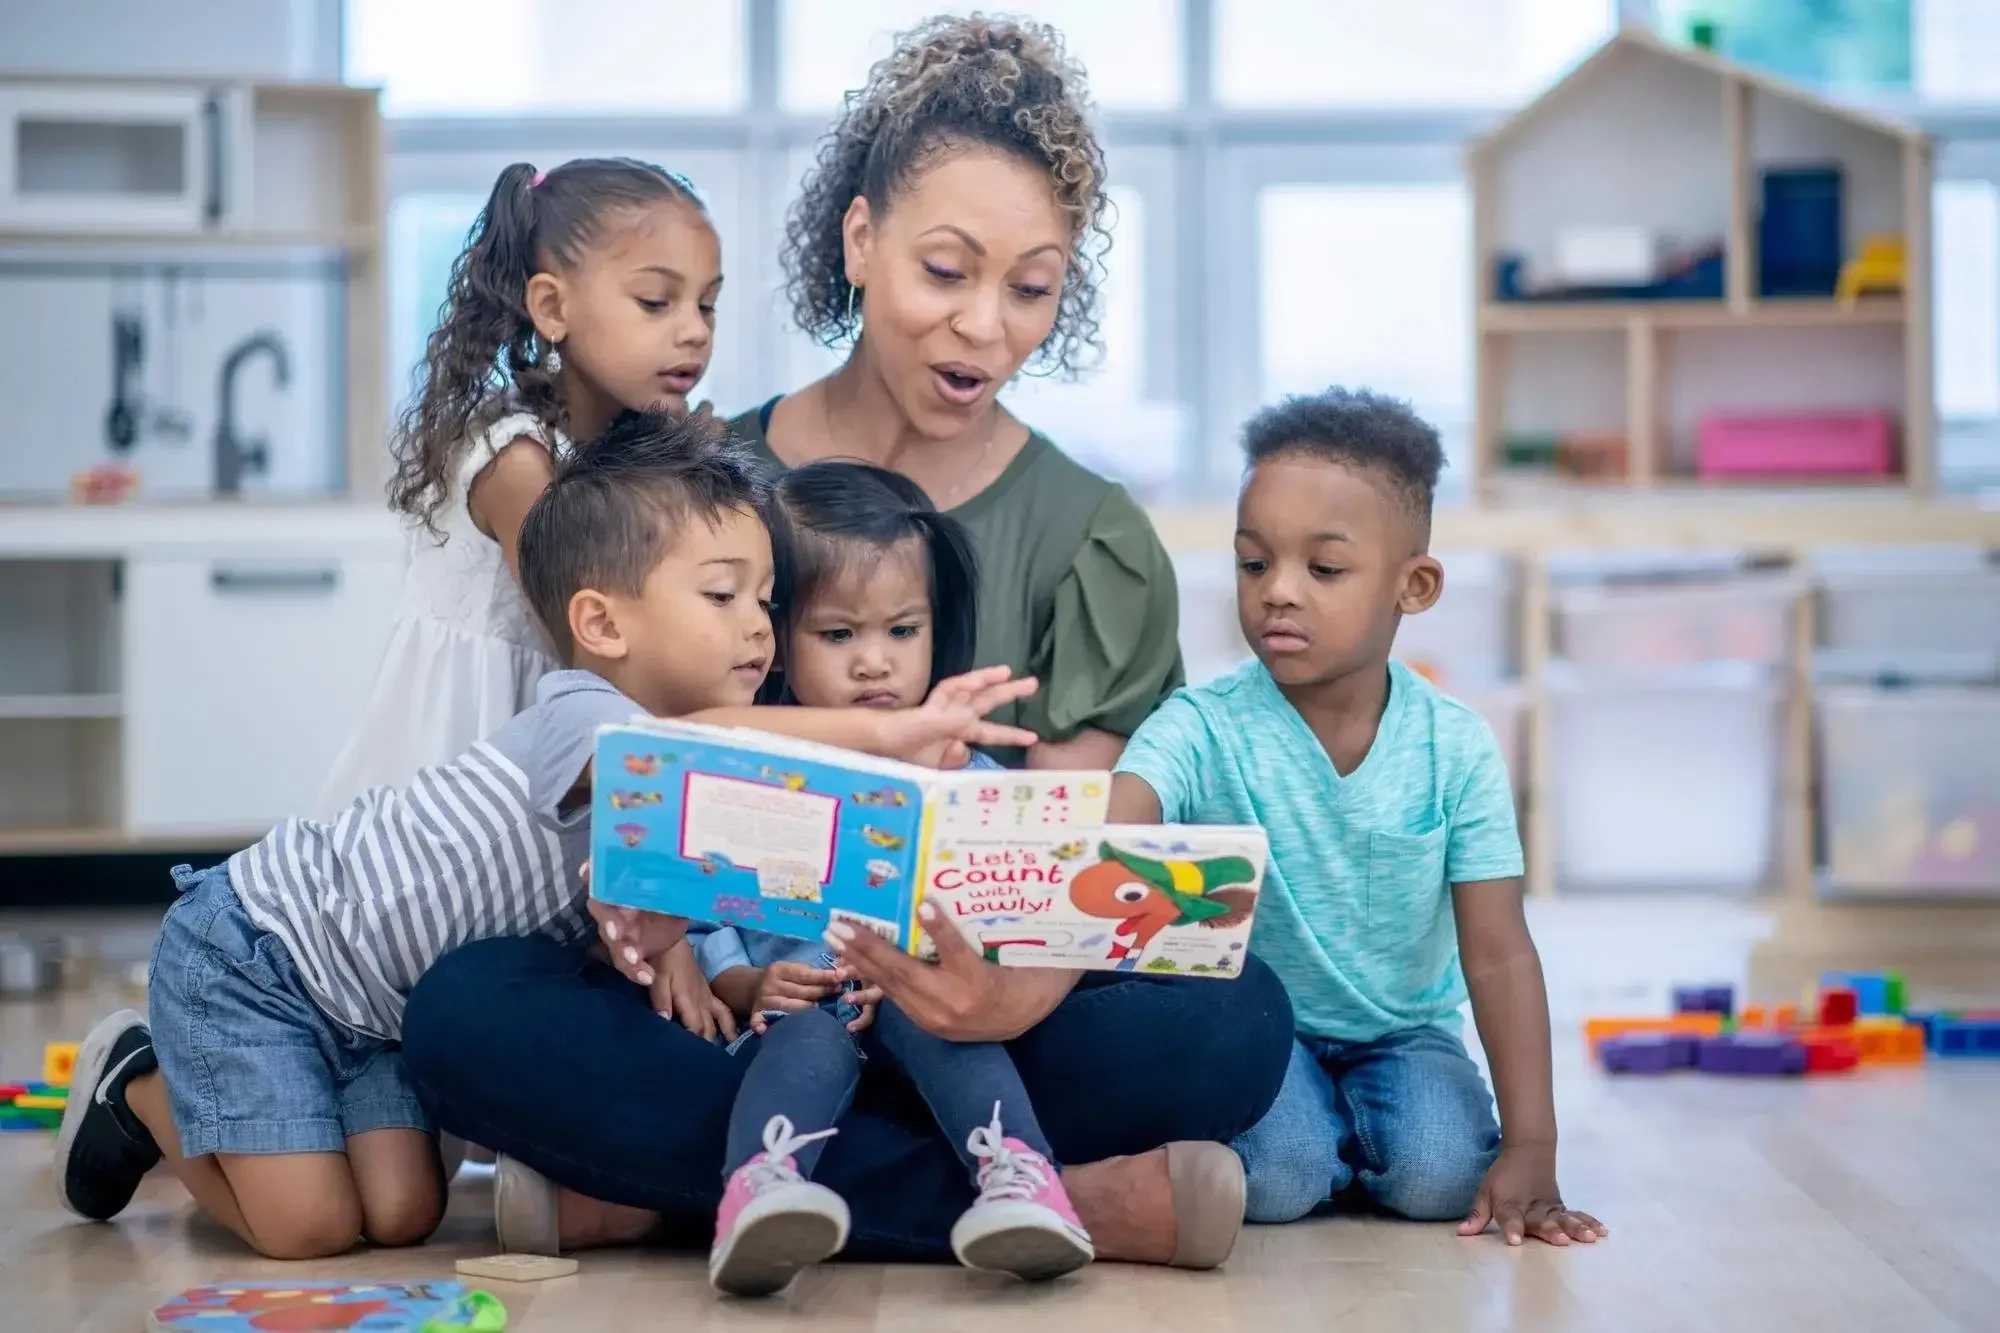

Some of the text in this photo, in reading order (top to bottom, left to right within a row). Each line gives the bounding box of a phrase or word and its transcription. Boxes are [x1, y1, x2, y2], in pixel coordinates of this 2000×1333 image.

[977, 785, 999, 802] 2
[1047, 784, 1068, 800] 4
[968, 848, 1037, 866] Let's
[933, 864, 1064, 889] Count
[968, 885, 1021, 898] with
[955, 897, 1052, 916] Lowly!
